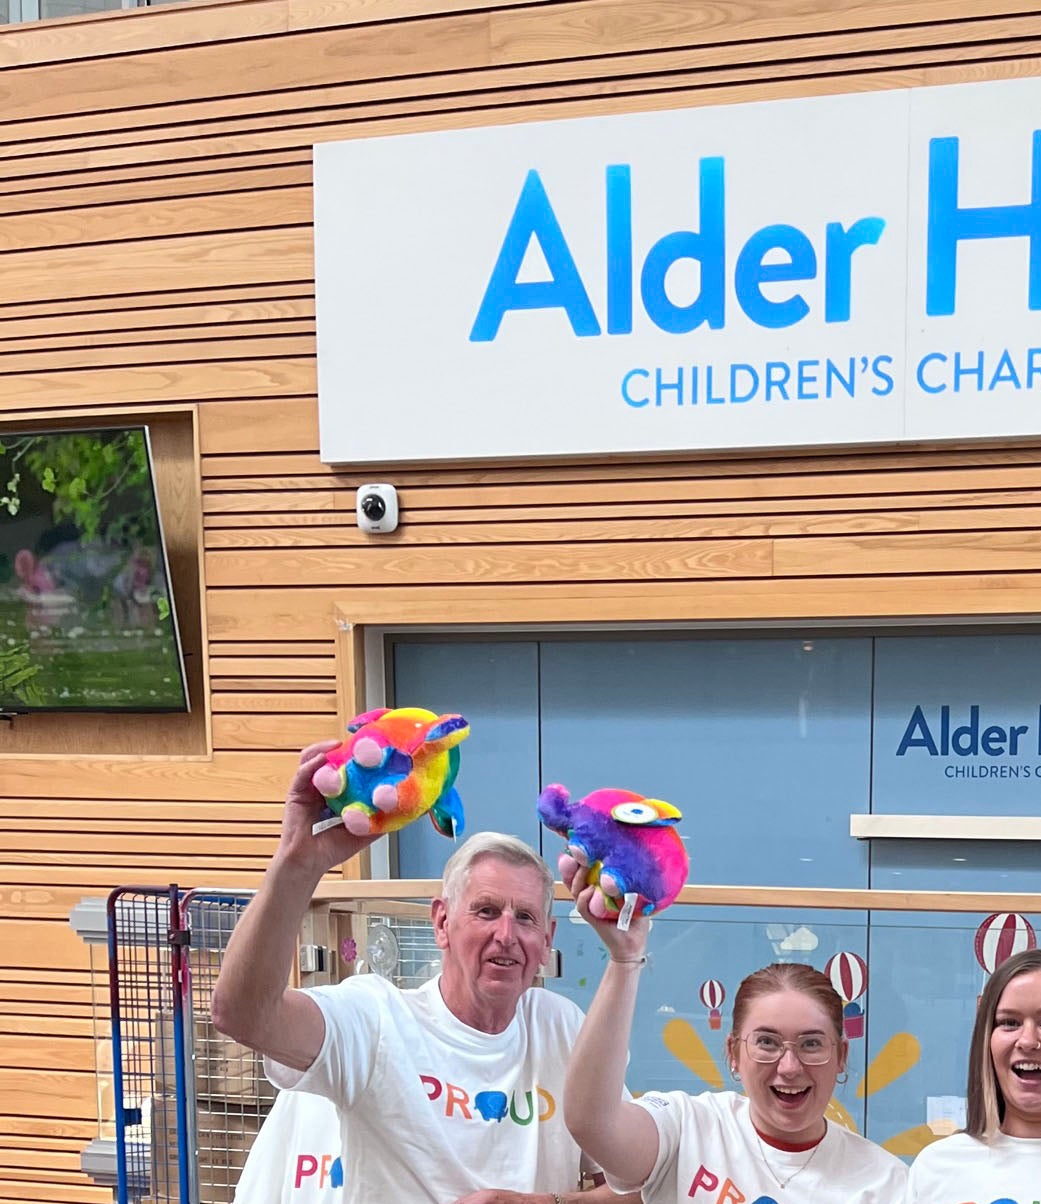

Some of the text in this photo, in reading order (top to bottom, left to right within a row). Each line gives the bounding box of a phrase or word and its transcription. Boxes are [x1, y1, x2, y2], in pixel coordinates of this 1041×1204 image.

[469, 156, 886, 342] Alder
[620, 354, 895, 408] CHILDREN'S
[896, 705, 1029, 757] Alder
[944, 765, 1031, 778] CHILDREN'S
